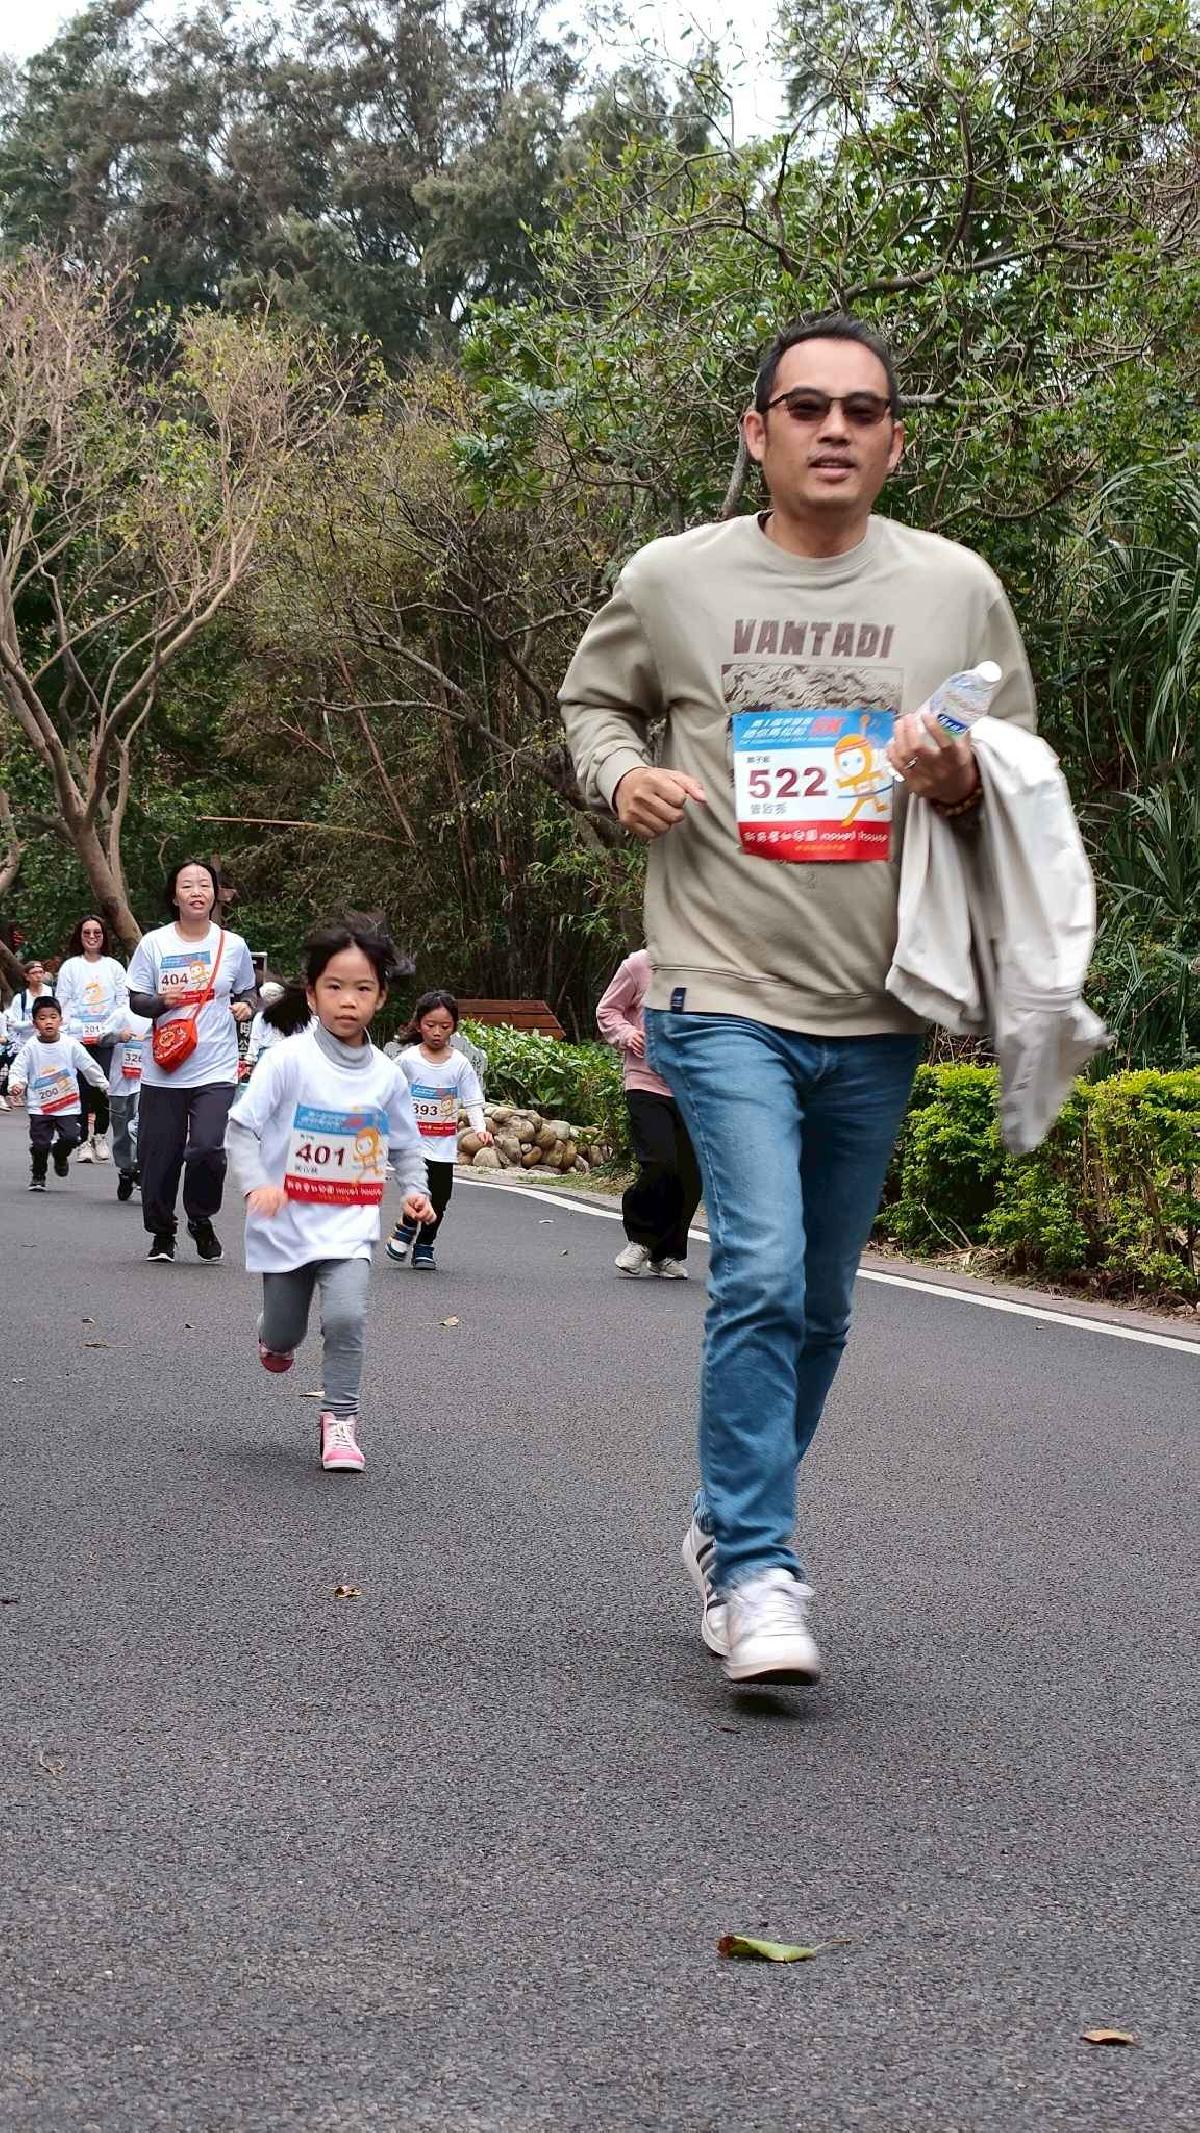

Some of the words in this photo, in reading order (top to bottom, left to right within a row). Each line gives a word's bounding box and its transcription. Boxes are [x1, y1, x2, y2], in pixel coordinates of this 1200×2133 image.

[733, 619, 895, 658] VANTADI
[749, 767, 828, 799] 522
[161, 973, 188, 985] 404
[295, 1143, 345, 1167] 401
